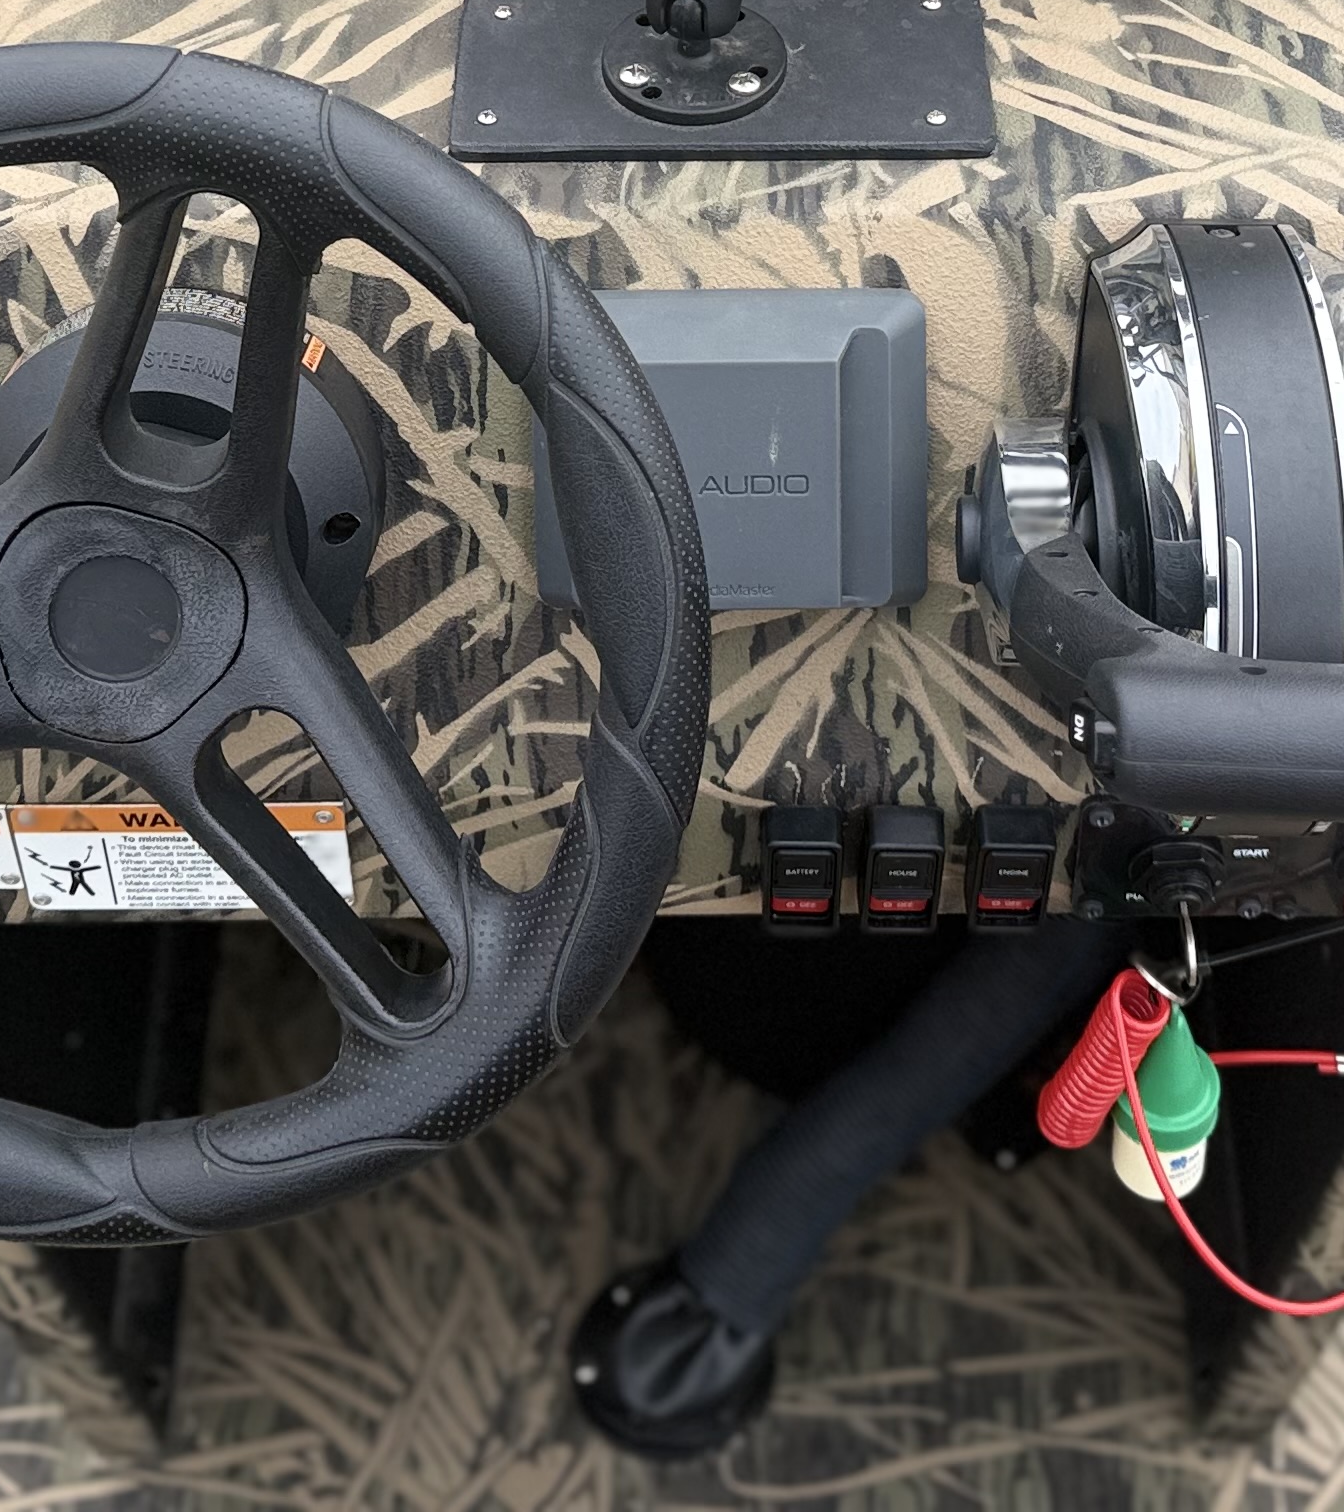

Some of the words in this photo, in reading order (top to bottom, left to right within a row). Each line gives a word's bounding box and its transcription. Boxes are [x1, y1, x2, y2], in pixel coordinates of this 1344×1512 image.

[143, 350, 236, 384] STEERING
[698, 474, 810, 495] AUDIO
[1233, 848, 1270, 859] START
